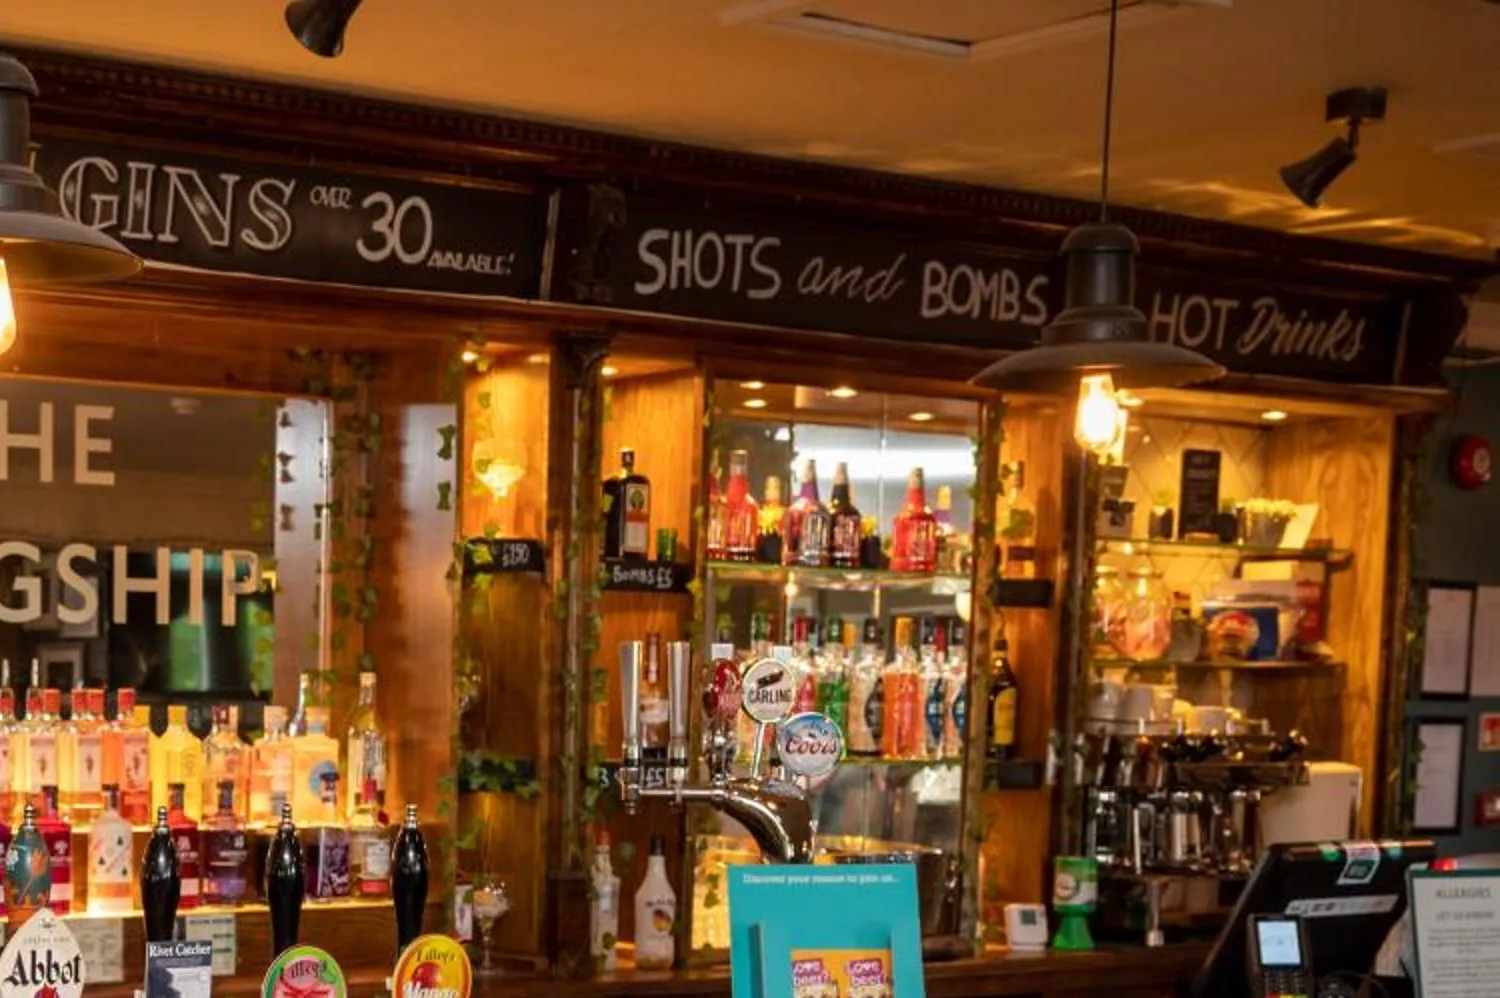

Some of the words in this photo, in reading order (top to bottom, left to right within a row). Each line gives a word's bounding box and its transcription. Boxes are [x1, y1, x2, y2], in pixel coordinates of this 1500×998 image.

[58, 155, 296, 252] GINS
[355, 191, 433, 265] 30
[634, 229, 781, 299] SHOTS
[798, 250, 906, 304] and
[921, 260, 1049, 327] BOMBS
[1150, 293, 1238, 349] HOT
[1238, 295, 1367, 363] Drinks
[3, 949, 82, 987] Abbot
